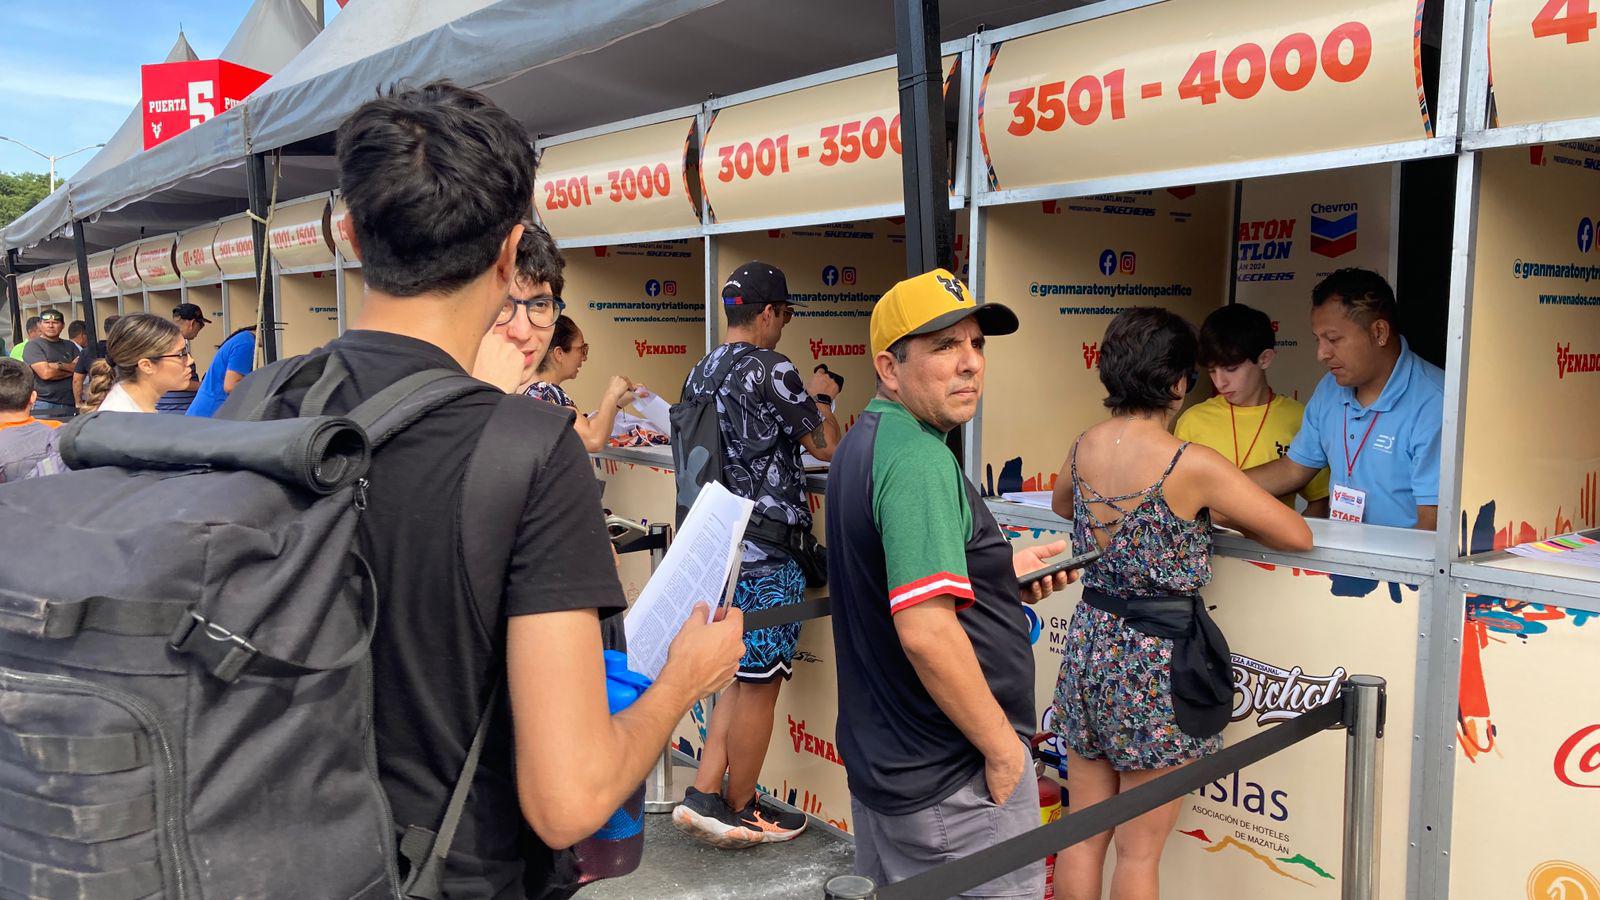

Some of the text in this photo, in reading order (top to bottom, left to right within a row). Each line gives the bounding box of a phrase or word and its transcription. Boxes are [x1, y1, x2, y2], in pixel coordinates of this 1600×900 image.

[1007, 22, 1373, 138] 3501 - 4000
[149, 98, 187, 113] PUERTA
[188, 80, 215, 129] 5
[718, 135, 790, 184] 3001
[797, 146, 809, 159] -
[544, 163, 671, 211] 2501 - 3000
[1103, 205, 1157, 217] SKECHERS
[1311, 202, 1358, 214] Chevron
[272, 230, 292, 248] 1001
[296, 224, 317, 245] 1500
[824, 230, 874, 239] SKECHERS
[634, 340, 687, 358] VENADOS
[809, 337, 867, 360] VENADOS
[1332, 510, 1361, 523] STAFF
[787, 714, 845, 767] VENA
[1192, 805, 1290, 843] ASOCIACIÓN DE HOTELES
[1235, 831, 1290, 855] DE MAZATLÁN
